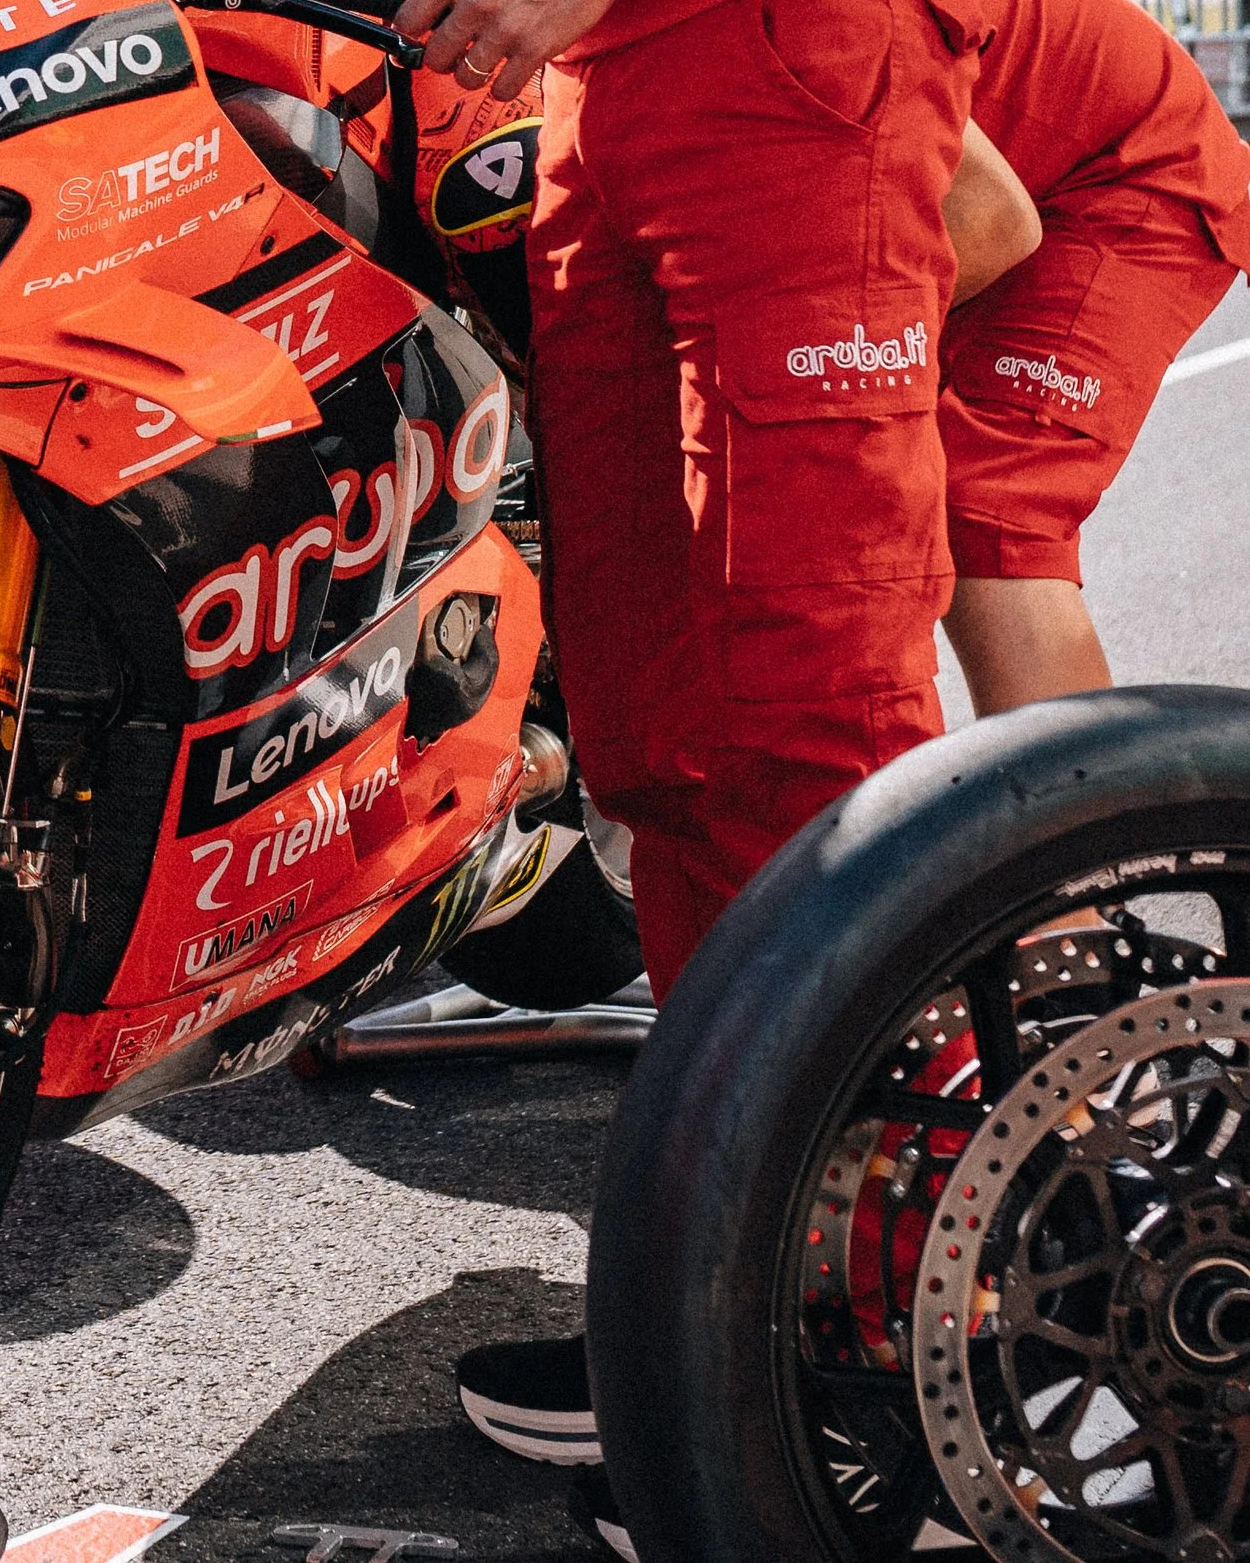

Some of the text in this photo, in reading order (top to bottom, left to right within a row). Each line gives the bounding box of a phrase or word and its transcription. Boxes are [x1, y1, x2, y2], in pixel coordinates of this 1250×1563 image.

[55, 126, 221, 223] SATECH
[56, 168, 219, 243] Modular Machine Guards
[22, 215, 202, 298] PANIGALE
[786, 321, 929, 379] aruba.it
[995, 353, 1102, 409] aruba.it
[822, 374, 914, 393] RACING
[1012, 380, 1080, 413] RACING
[213, 646, 401, 805] Lenovo
[184, 895, 297, 977] UMANA
[250, 944, 303, 991] NGK
